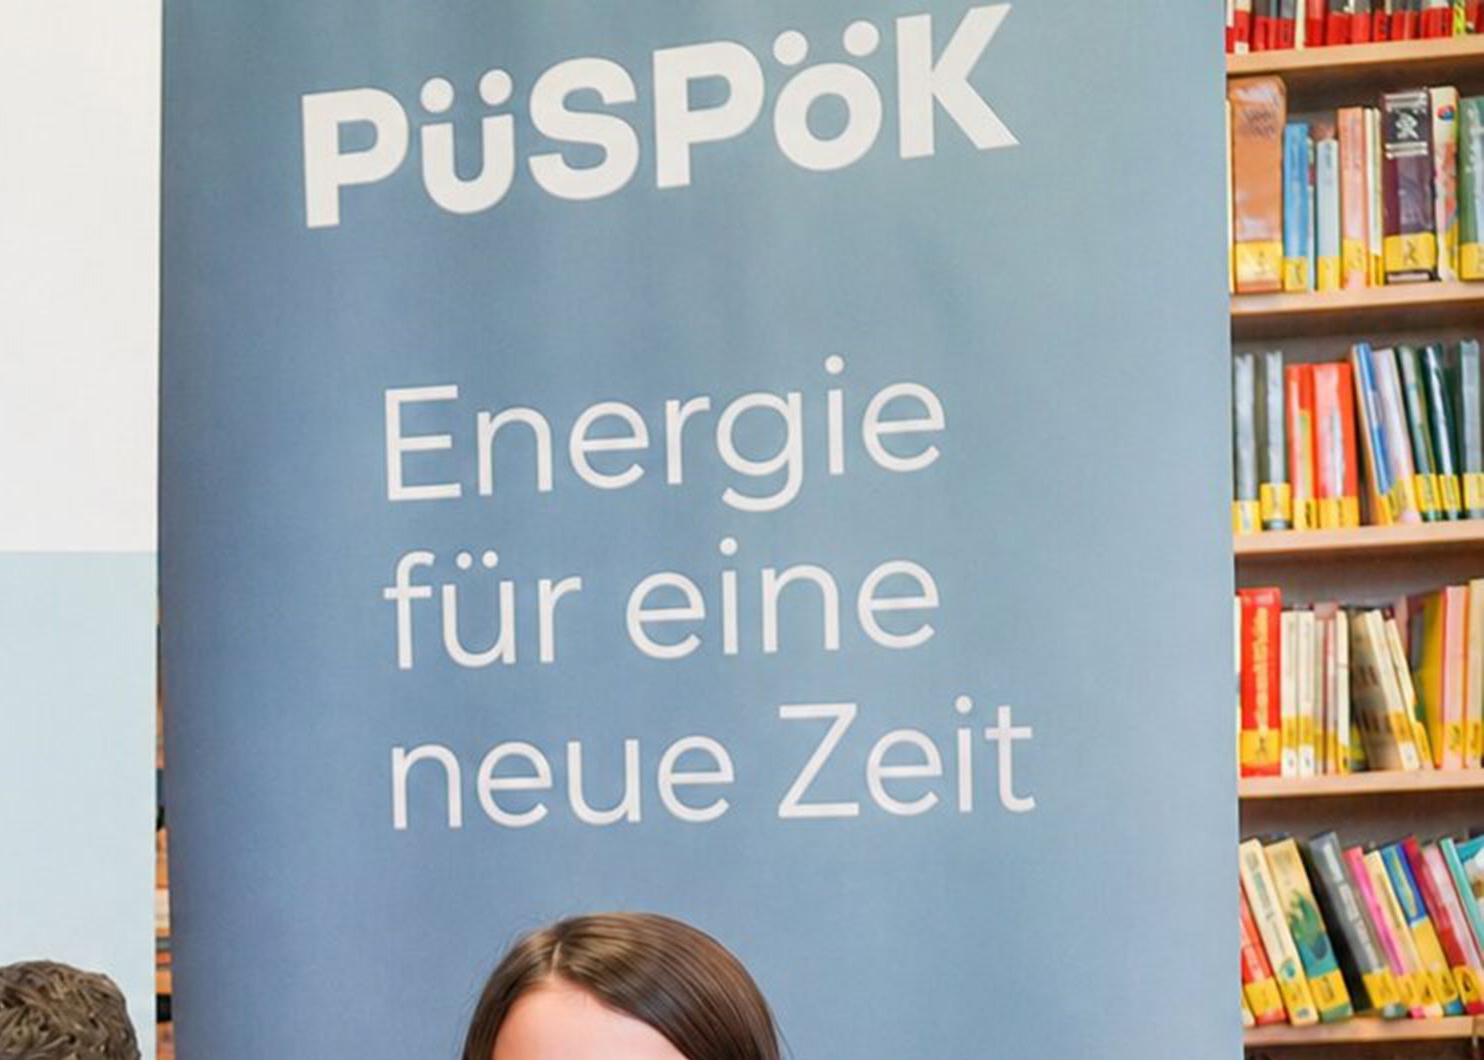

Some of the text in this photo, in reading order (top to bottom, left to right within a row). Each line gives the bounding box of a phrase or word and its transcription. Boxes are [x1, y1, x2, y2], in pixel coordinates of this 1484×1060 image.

[384, 355, 945, 512] Energie
[383, 537, 940, 669] für eine
[392, 695, 1036, 829] neue Zeit
